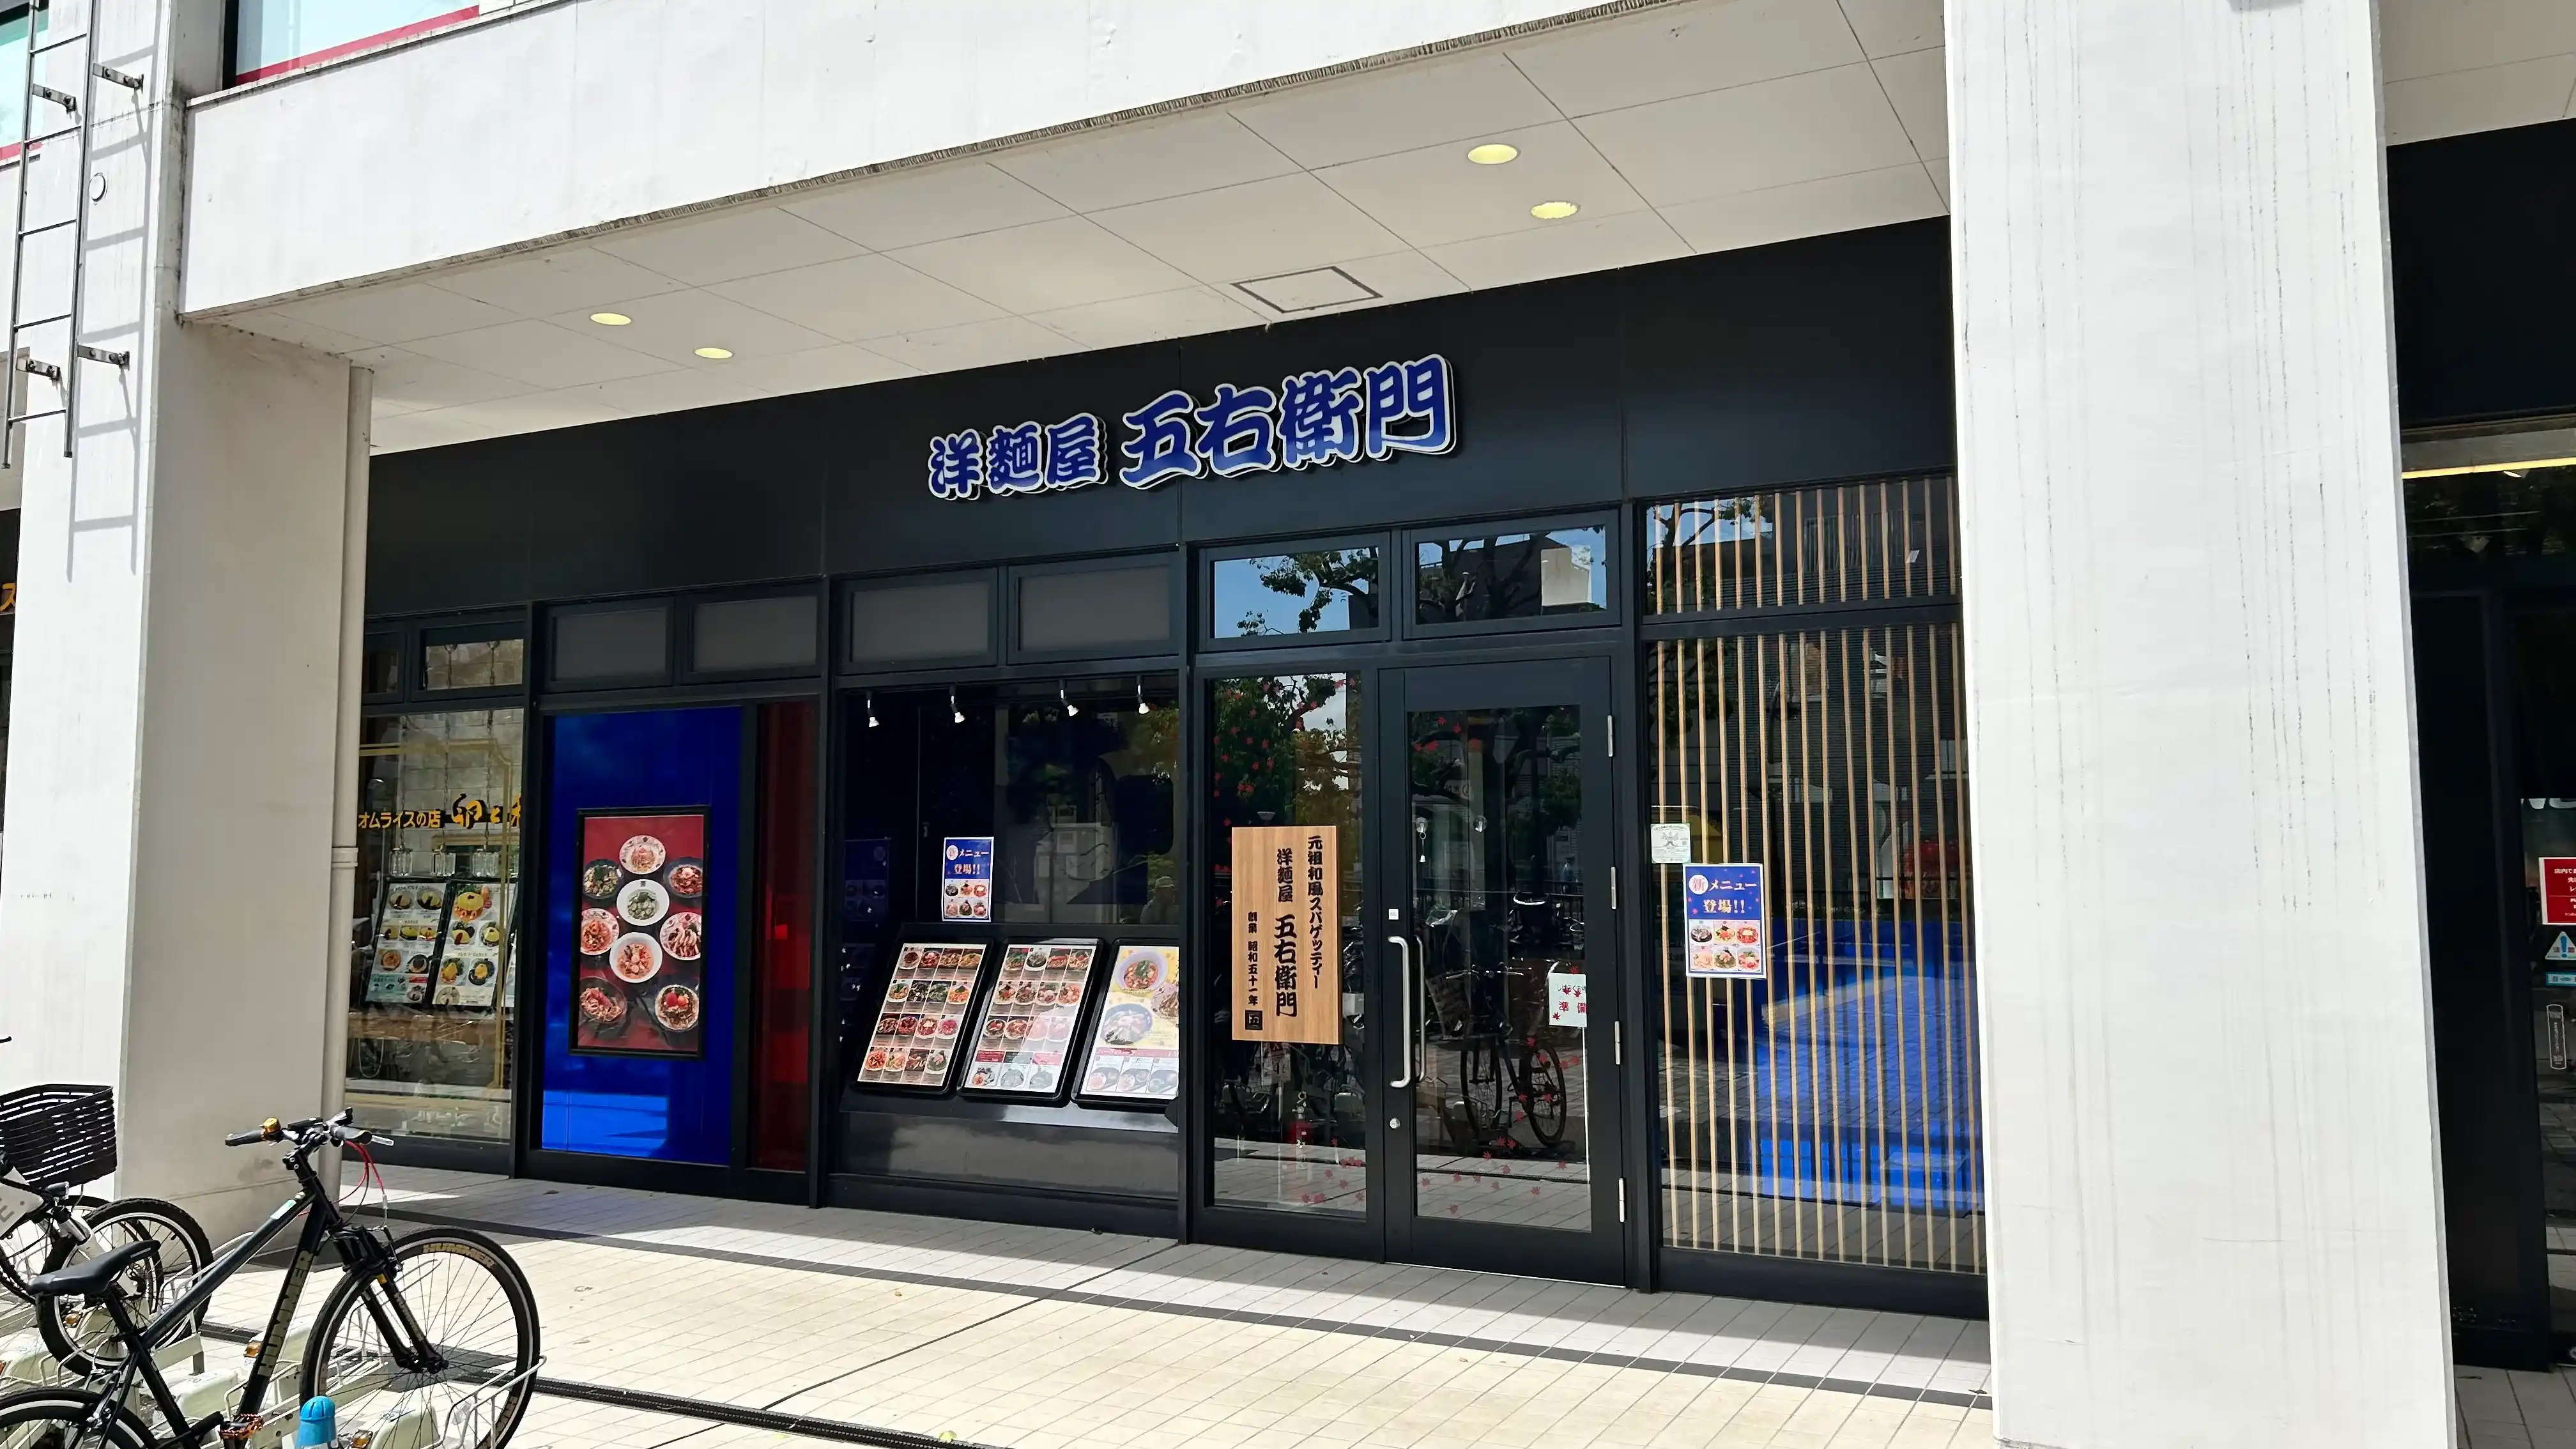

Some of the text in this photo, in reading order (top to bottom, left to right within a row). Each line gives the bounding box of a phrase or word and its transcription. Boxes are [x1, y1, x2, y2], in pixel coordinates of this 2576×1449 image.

[1119, 353, 1452, 487] 五右衛門
[358, 810, 441, 829] オムライスの店
[1248, 941, 1258, 1006] 昭和五十一年
[1274, 914, 1298, 1017] 五右衛門
[257, 1250, 314, 1377] HUMMER
